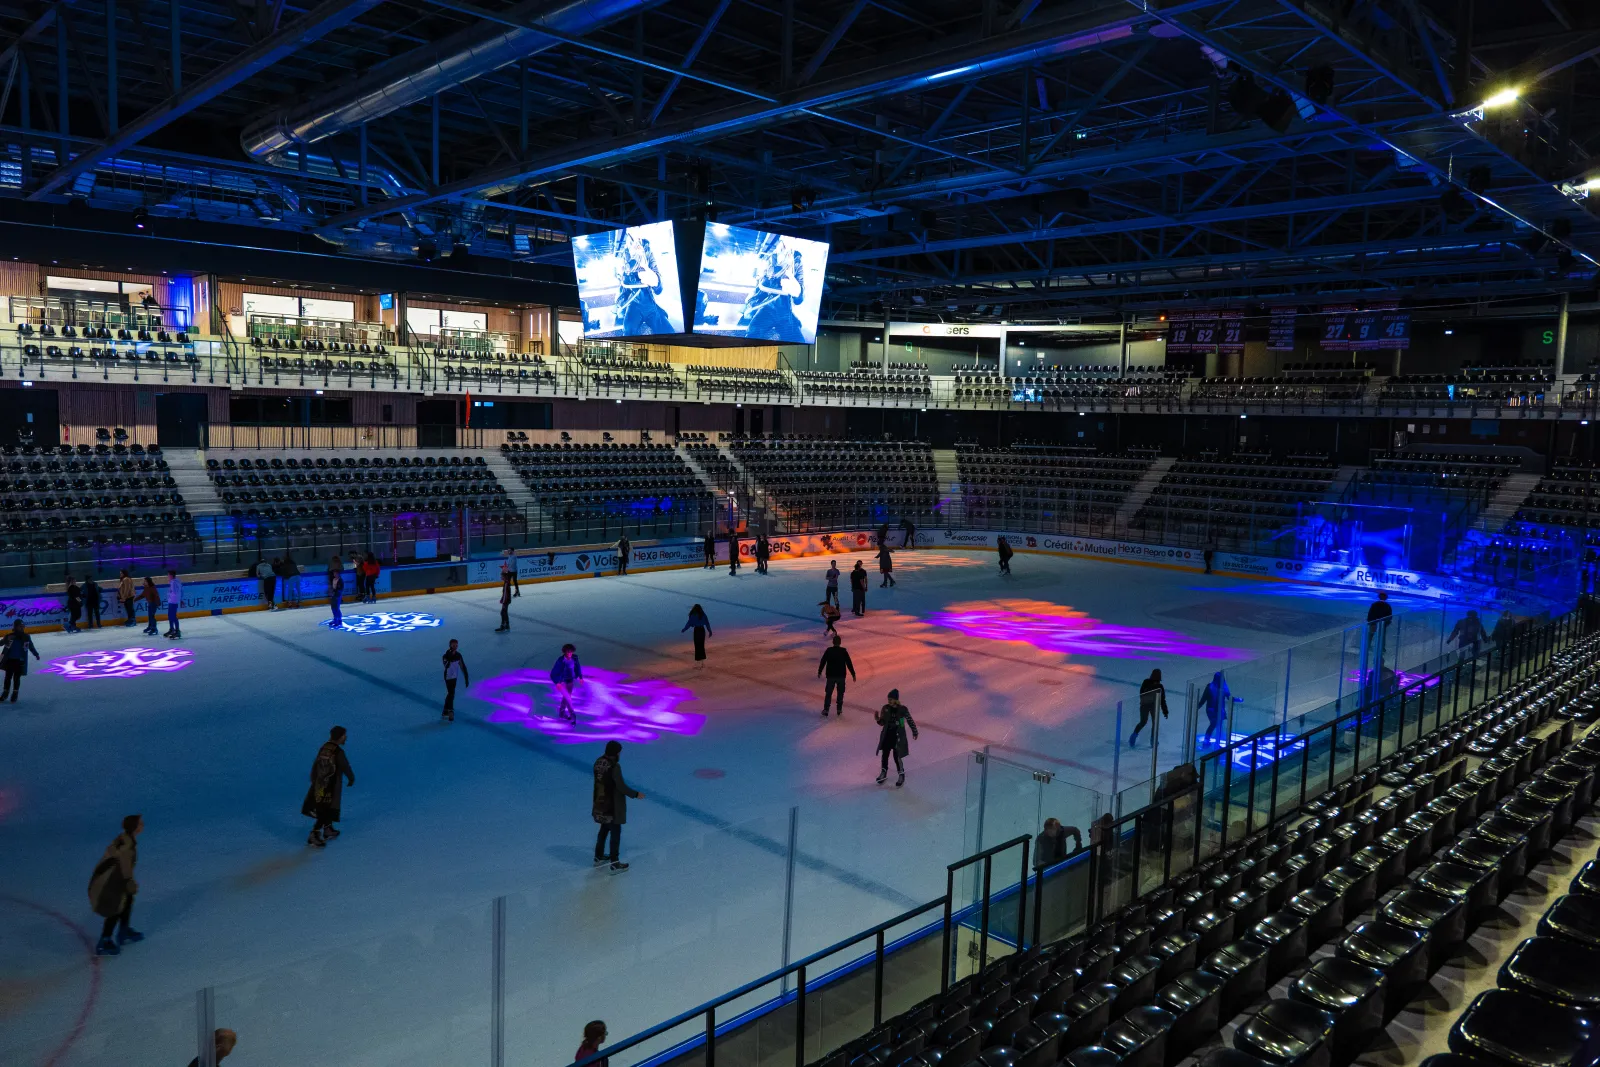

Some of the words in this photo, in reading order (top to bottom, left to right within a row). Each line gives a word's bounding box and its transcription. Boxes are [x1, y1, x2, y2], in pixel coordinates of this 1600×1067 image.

[1197, 330, 1213, 342] 62
[1225, 330, 1240, 342] 21
[1326, 325, 1345, 339] 27
[1360, 325, 1370, 339] 9
[1386, 322, 1405, 337] 45
[1173, 330, 1187, 343] 19
[1542, 331, 1554, 344] S
[906, 342, 913, 352] Q
[1044, 539, 1073, 550] Crédit
[1084, 543, 1117, 555] Mutuel
[1118, 543, 1141, 554] Hexa
[1144, 548, 1167, 557] Repro
[633, 550, 657, 561] Hexa
[659, 550, 681, 559] Repro
[479, 562, 486, 571] 9
[210, 592, 264, 604] PARE-BRISE
